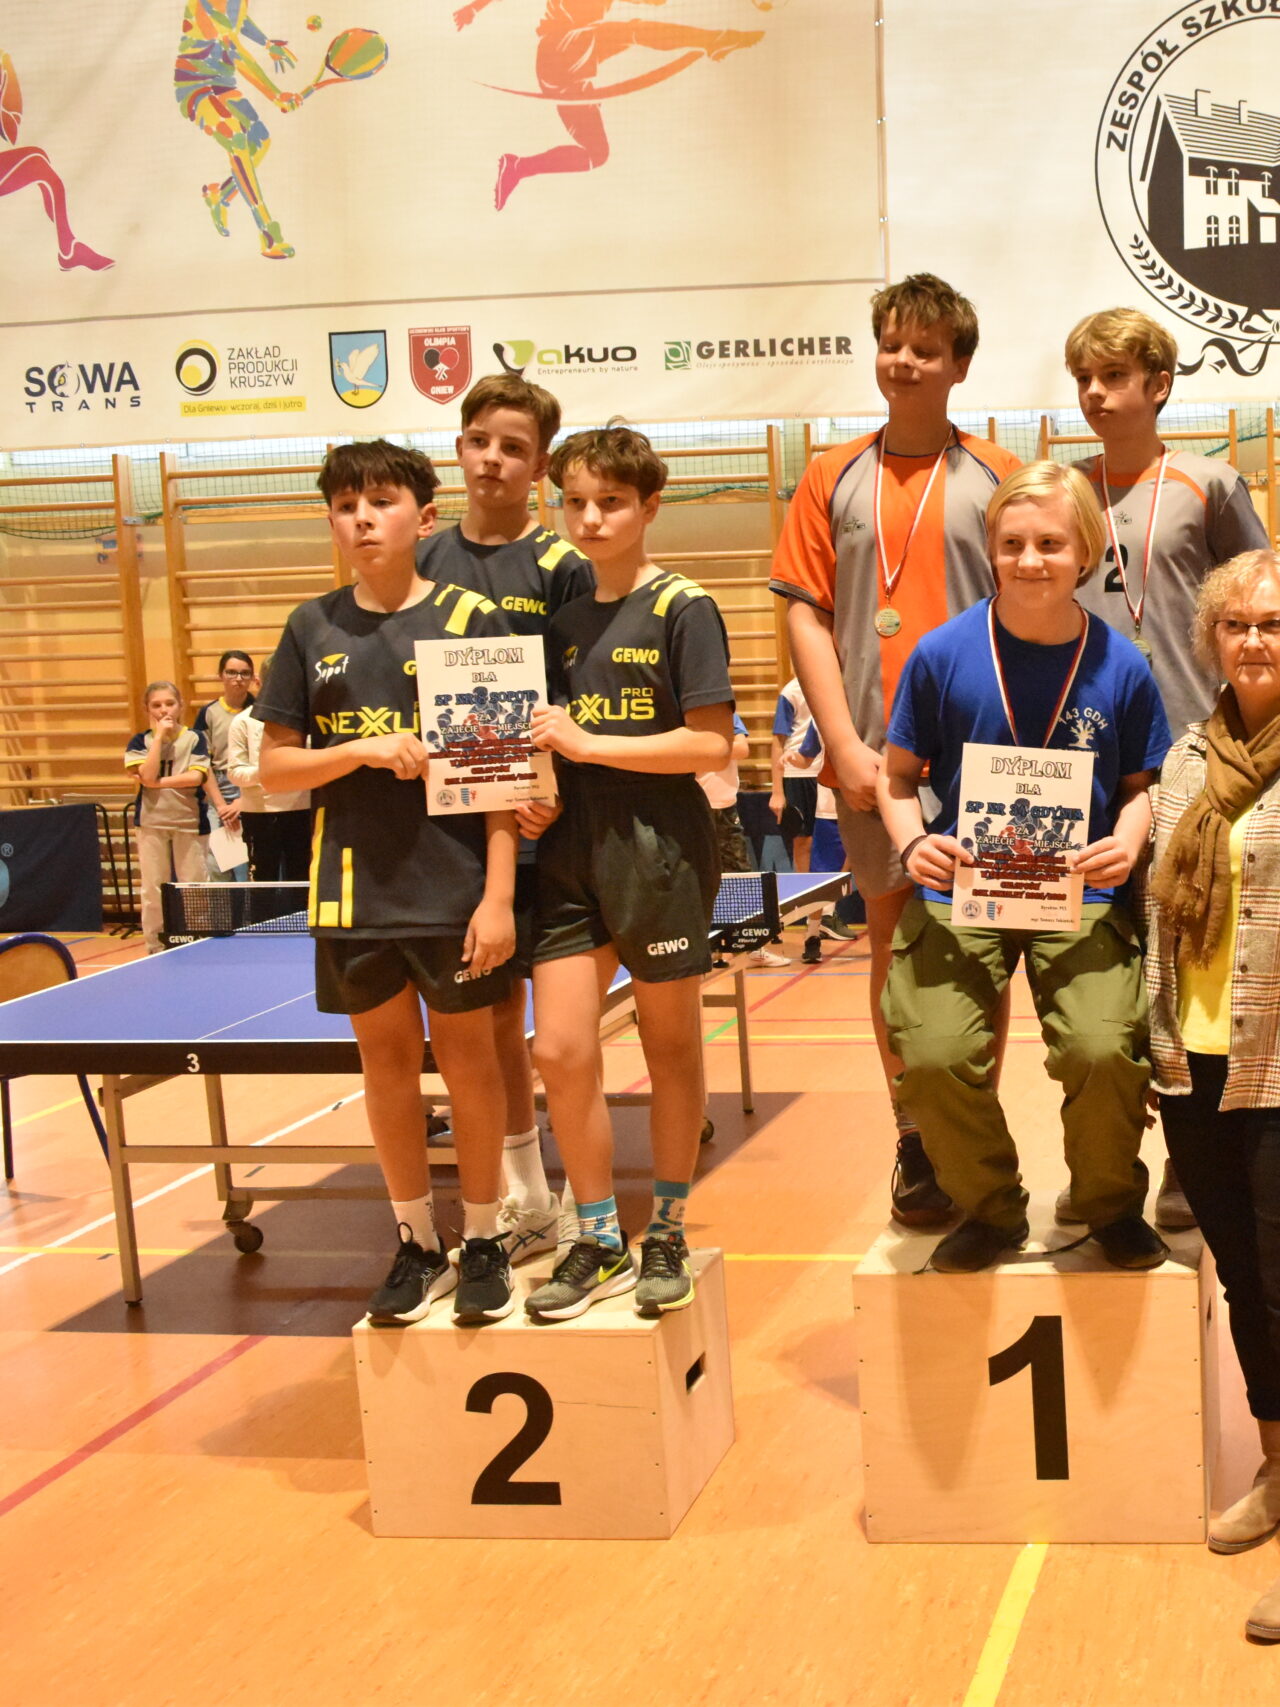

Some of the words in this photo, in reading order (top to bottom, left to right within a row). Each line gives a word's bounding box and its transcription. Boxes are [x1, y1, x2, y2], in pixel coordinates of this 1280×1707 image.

[1106, 38, 1180, 152] ZESPÓŁ
[227, 345, 281, 360] ZAKŁAD
[537, 345, 637, 364] akuo
[696, 336, 853, 360] GERLICHER
[228, 359, 298, 374] PRODUKCJI
[537, 367, 595, 375] Entrepreneurs
[230, 373, 295, 388] KRUSZYW
[25, 396, 141, 413] TRANS
[1104, 544, 1128, 592] 2
[444, 647, 524, 667] DYPLOM
[612, 647, 659, 665] GEWO
[315, 656, 349, 684] Sopot
[472, 672, 497, 683] DLA
[621, 688, 653, 697] PRO
[497, 722, 532, 733] MIEJSC
[1083, 707, 1109, 730] GDH
[991, 756, 1072, 779] DYPLOM
[1016, 783, 1041, 795] DLA
[1033, 839, 1073, 850] MIEJSCE
[169, 935, 194, 944] GEWO
[742, 929, 770, 937] GEWO
[647, 937, 689, 956] GEWO
[186, 1053, 200, 1073] 3
[987, 1315, 1070, 1481] 1
[464, 1372, 562, 1507] 2
